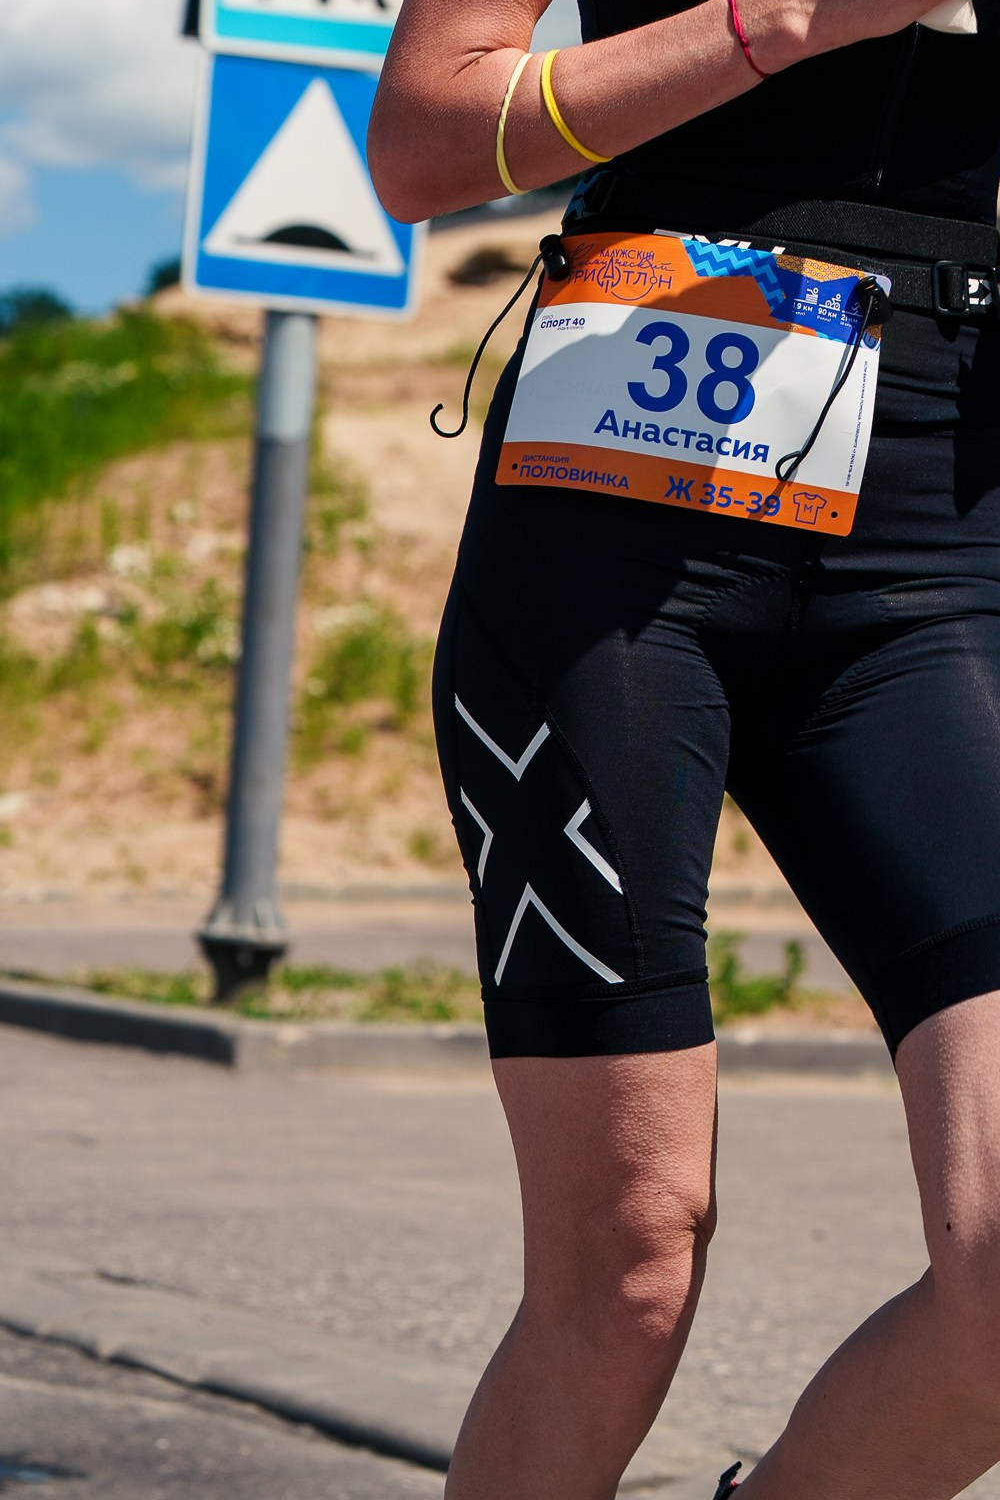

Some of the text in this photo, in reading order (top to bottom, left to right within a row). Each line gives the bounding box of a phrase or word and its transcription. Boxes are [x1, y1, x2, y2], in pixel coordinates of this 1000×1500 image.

[540, 318, 572, 329] СПОРТ
[572, 317, 586, 326] 40
[627, 321, 760, 425] 38
[593, 409, 770, 463] Анастасия
[521, 454, 570, 464] ДИСТАНЦИЯ
[519, 464, 630, 490] ПОЛОВИНКА
[664, 475, 781, 517] Ж 35-39
